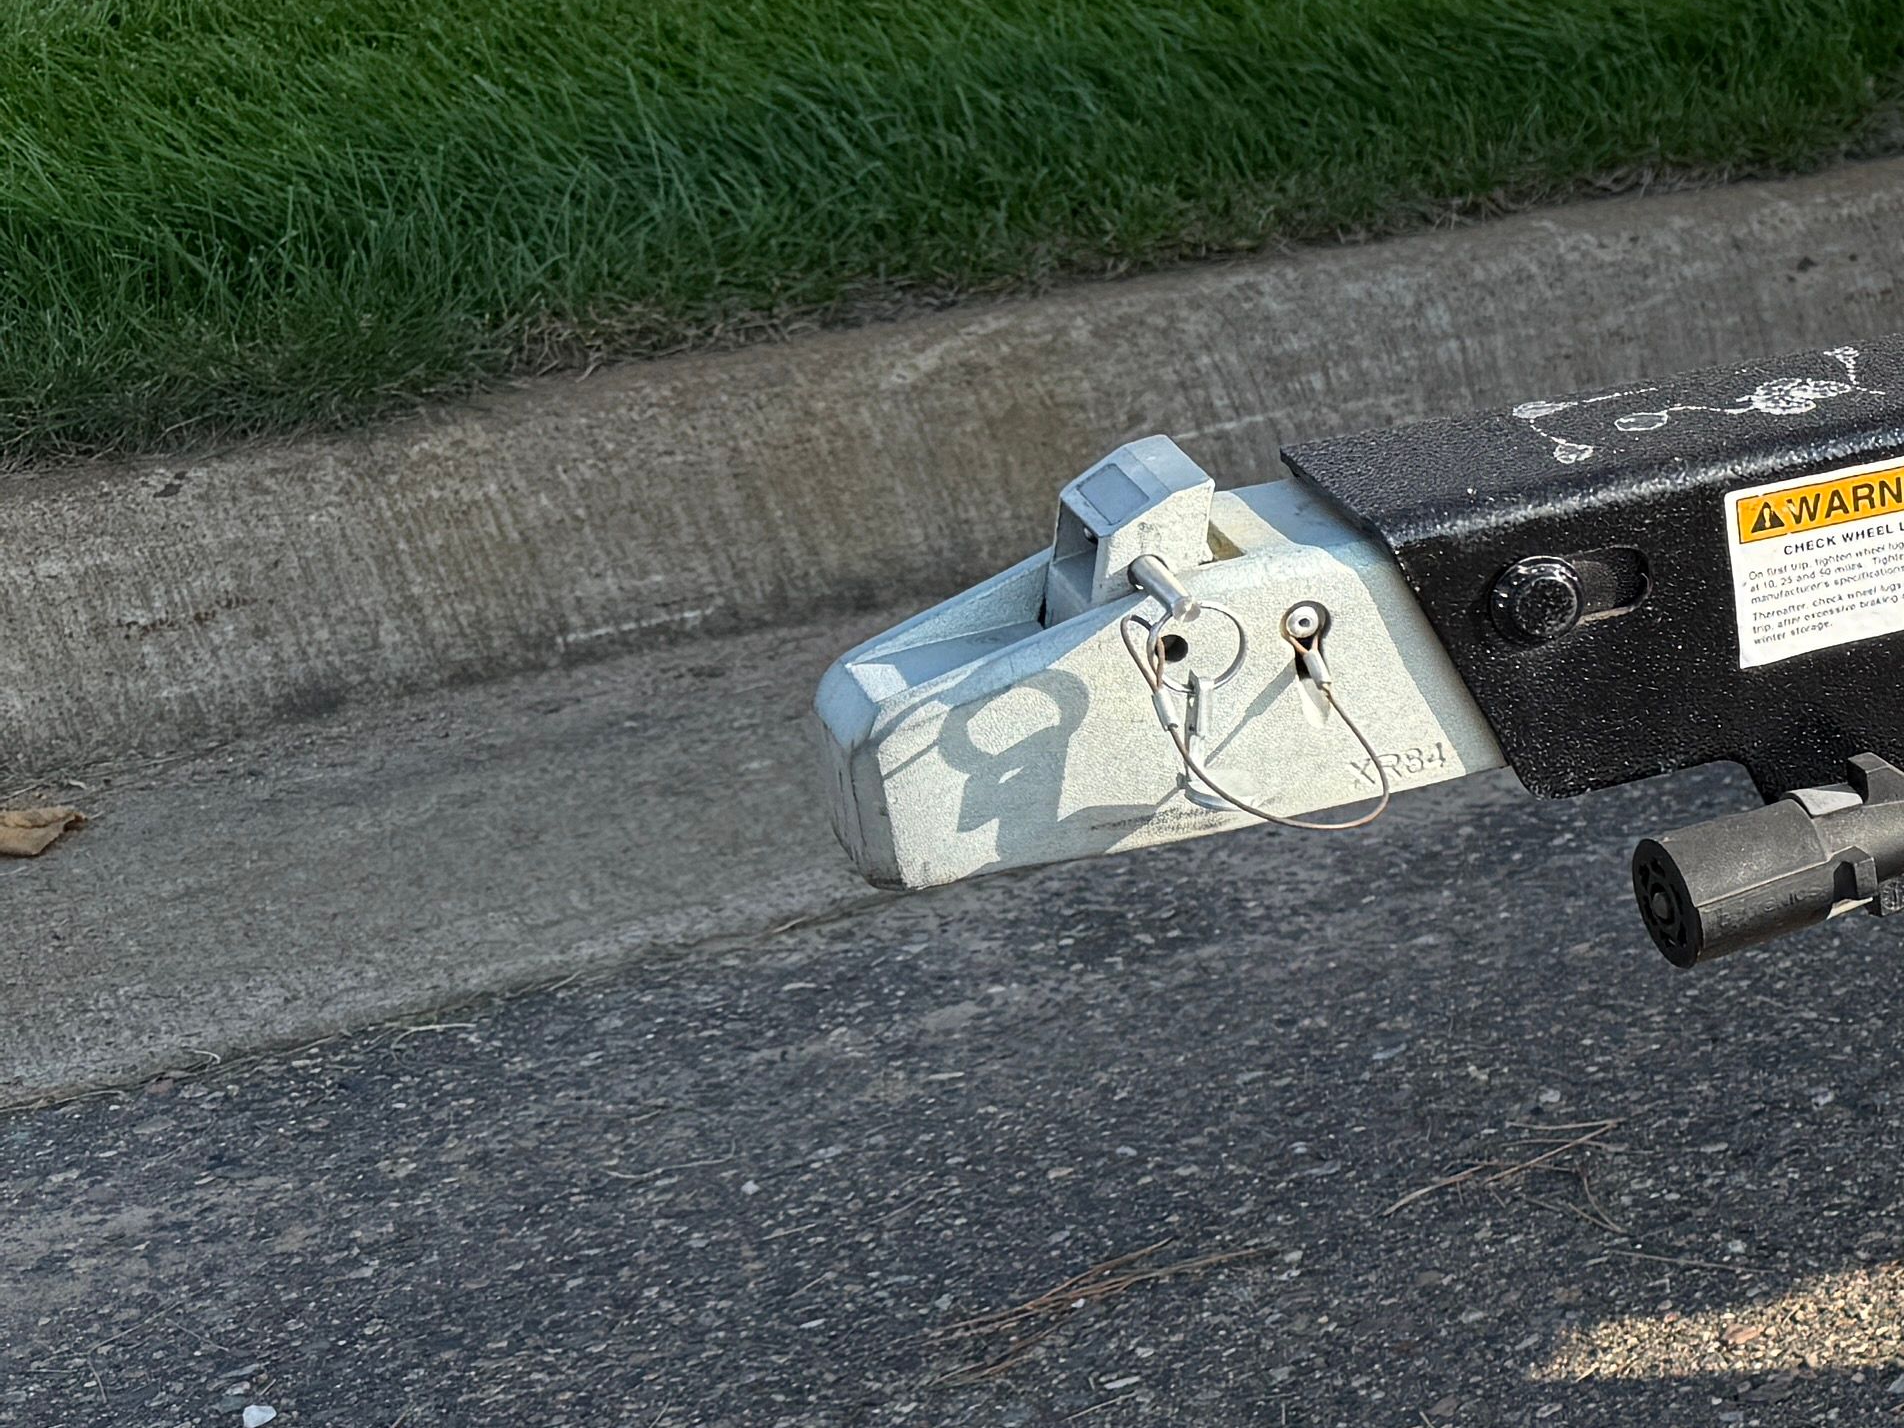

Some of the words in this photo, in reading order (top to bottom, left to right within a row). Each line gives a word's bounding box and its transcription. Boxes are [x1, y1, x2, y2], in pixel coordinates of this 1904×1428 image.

[1783, 535, 1837, 556] CHECK
[1841, 523, 1894, 544] WHEEL
[1748, 570, 1763, 581] On
[1796, 570, 1816, 583] and
